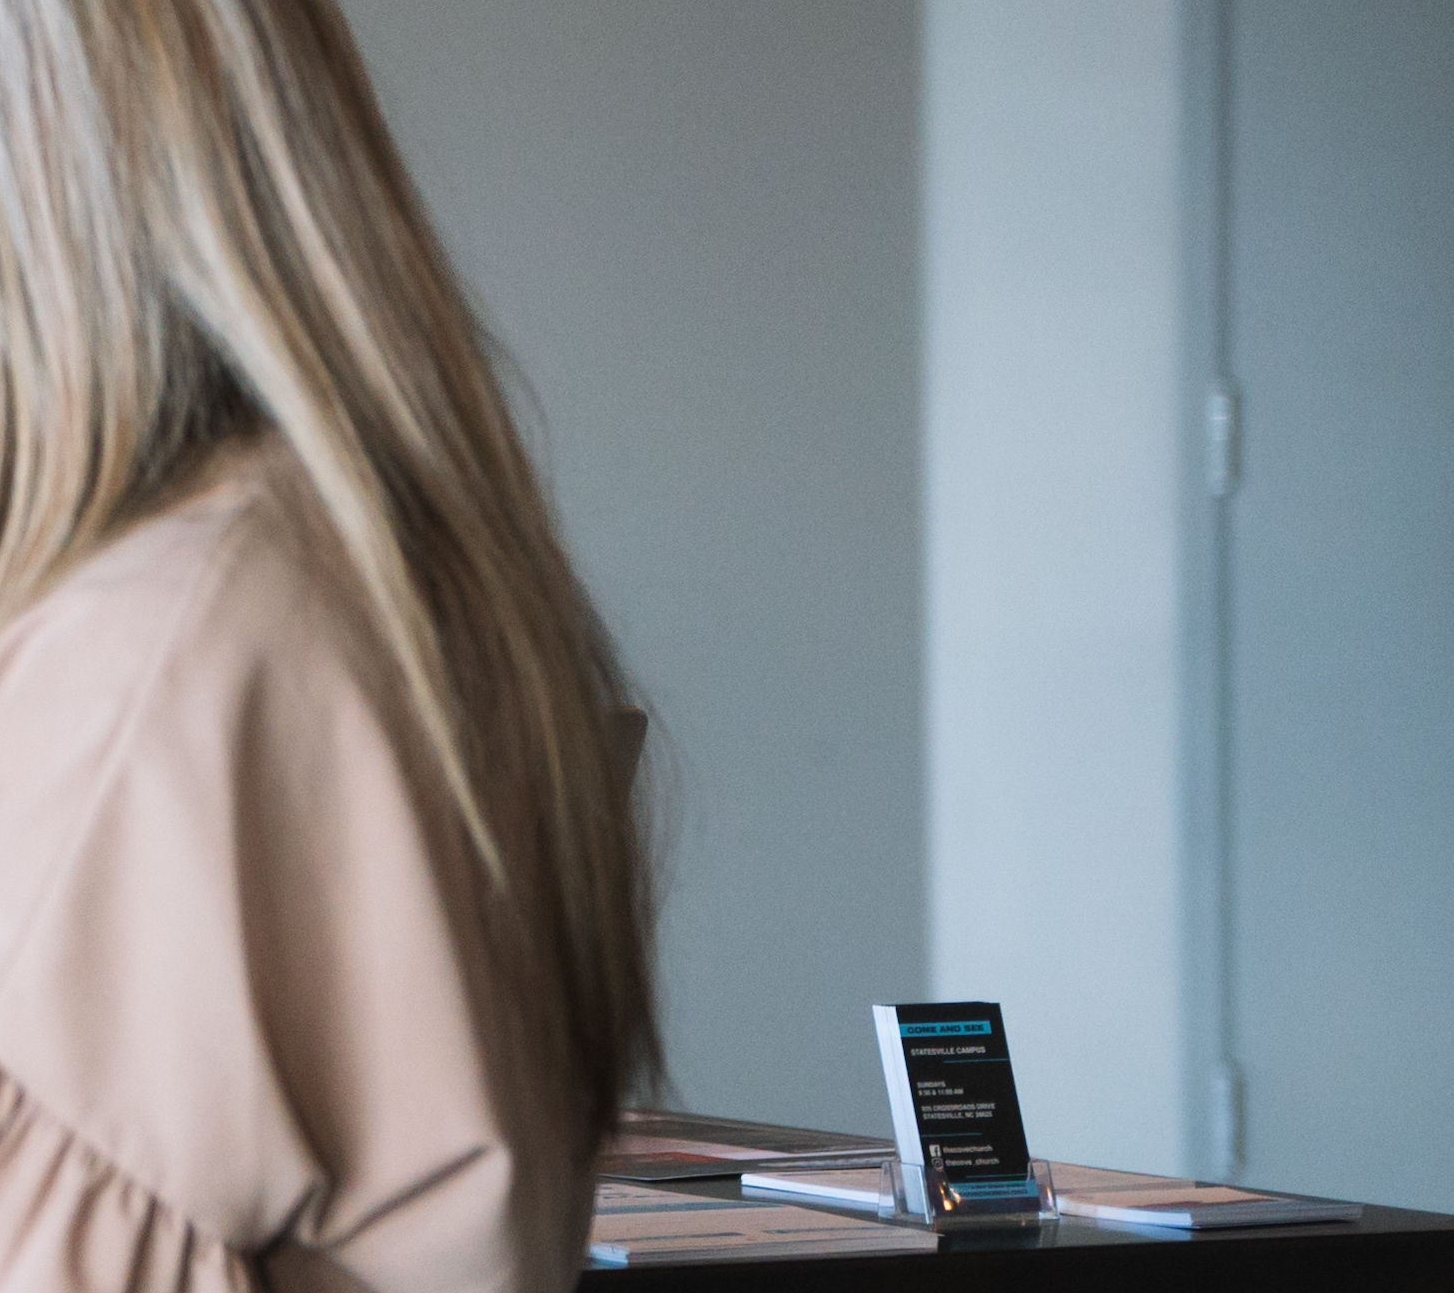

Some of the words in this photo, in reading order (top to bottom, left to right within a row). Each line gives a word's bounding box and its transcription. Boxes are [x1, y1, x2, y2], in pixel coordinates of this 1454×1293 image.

[907, 1026, 937, 1034] COME
[940, 1025, 961, 1033] AND
[963, 1024, 984, 1032] SEE
[910, 1047, 955, 1056] STATESVILLE
[956, 1046, 986, 1054] CAMPUS
